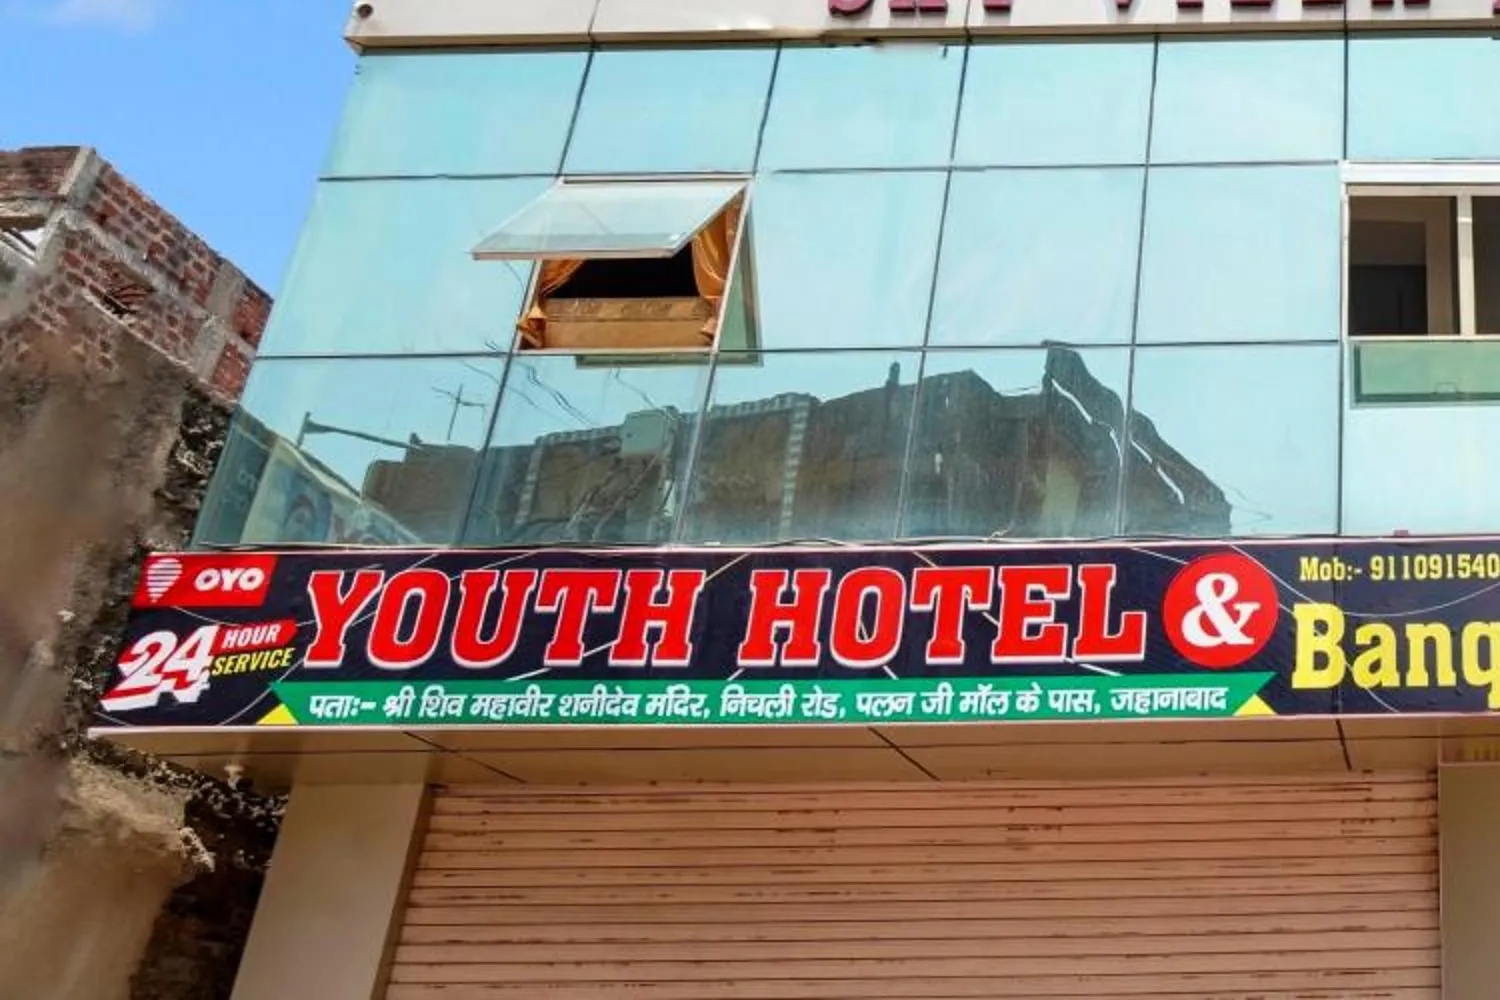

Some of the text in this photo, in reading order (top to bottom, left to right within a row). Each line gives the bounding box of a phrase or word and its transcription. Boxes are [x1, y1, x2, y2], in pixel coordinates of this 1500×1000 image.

[194, 568, 265, 592] OYO
[1299, 556, 1363, 581] Mob:-
[303, 563, 1260, 669] YOUTH HOTEL &
[100, 624, 281, 712] 24 HOUR
[212, 648, 296, 676] SERVICE
[383, 685, 416, 718] श्री
[418, 685, 465, 718] शिव
[469, 685, 555, 719] महावीर
[558, 684, 640, 718] शनीदेव
[921, 682, 954, 715] जी
[959, 683, 1011, 715] मॉल
[1015, 682, 1042, 714] के
[1109, 686, 1229, 713] जहानाबाद
